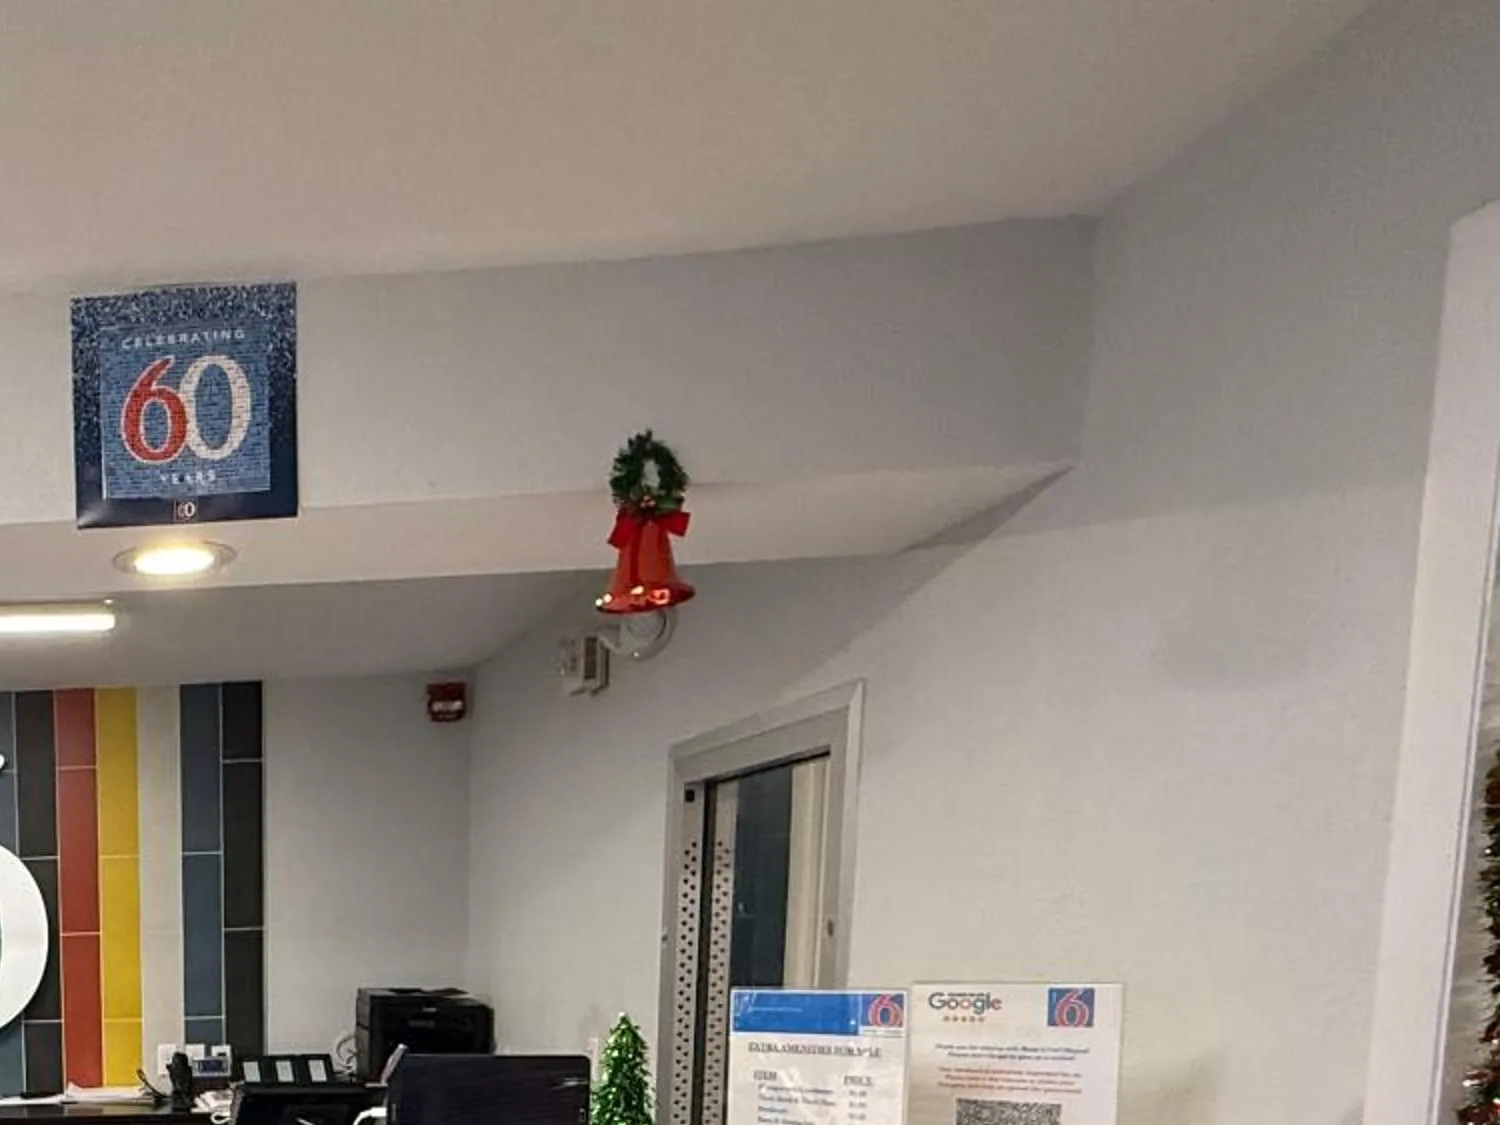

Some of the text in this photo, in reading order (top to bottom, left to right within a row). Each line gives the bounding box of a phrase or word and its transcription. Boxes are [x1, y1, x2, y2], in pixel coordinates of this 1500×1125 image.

[121, 327, 246, 350] CELEBRATING
[120, 354, 252, 464] 60
[928, 992, 1003, 1015] Google
[1054, 988, 1090, 1027] 6
